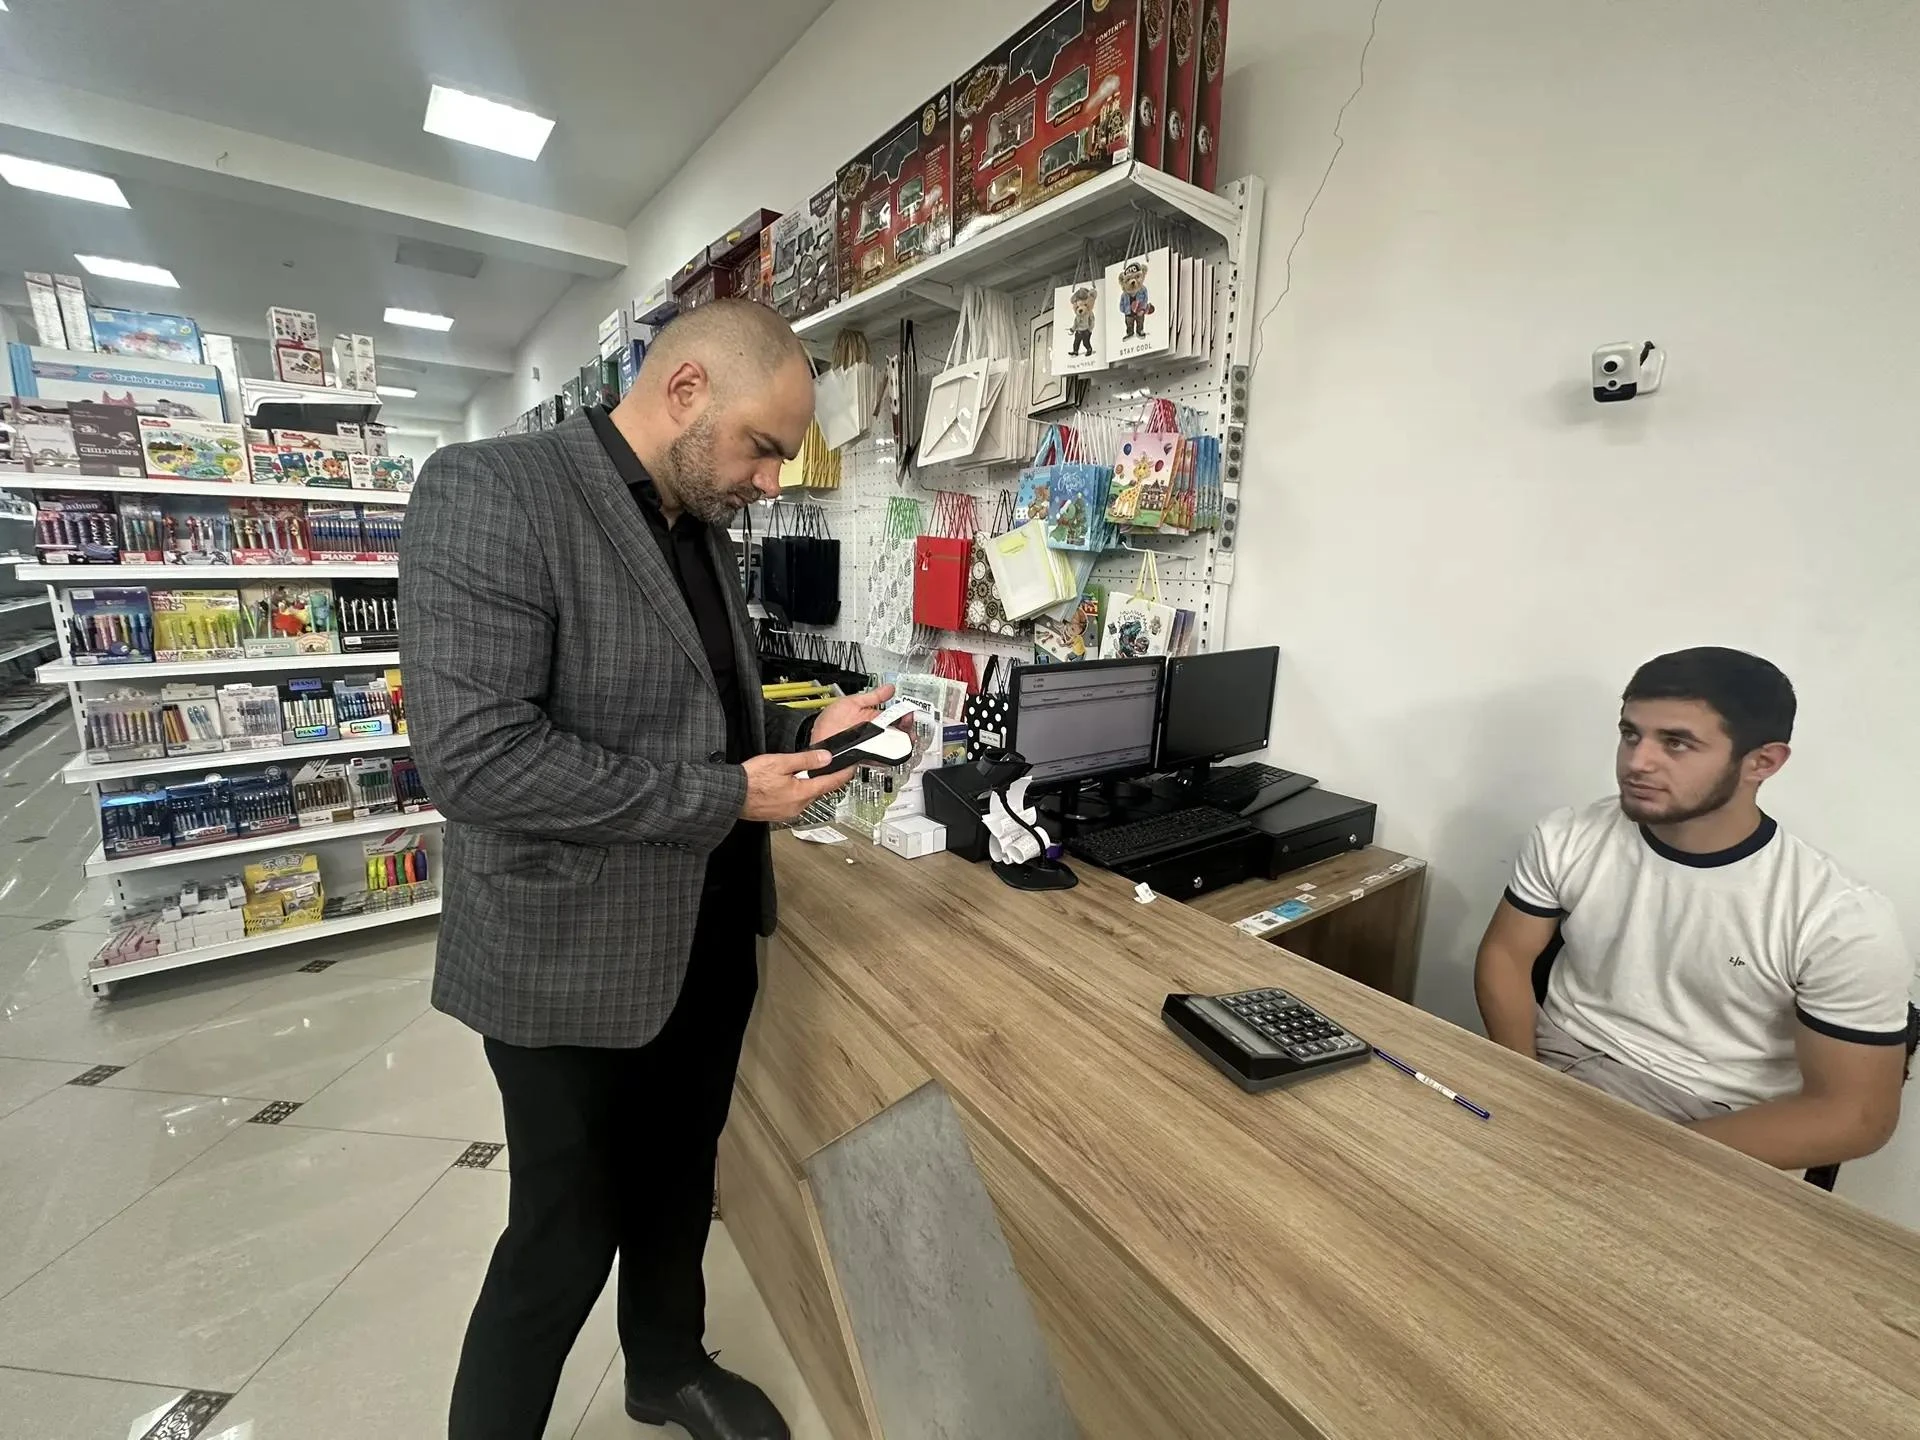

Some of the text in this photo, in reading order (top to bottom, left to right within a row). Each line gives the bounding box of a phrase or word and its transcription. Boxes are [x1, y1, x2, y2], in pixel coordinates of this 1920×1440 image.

[1120, 343, 1152, 356] STAY COOL
[113, 373, 143, 384] Train
[80, 446, 139, 456] CHILDREN'S
[65, 501, 98, 511] ashion
[321, 552, 354, 561] PIANO
[377, 554, 399, 562] PIAN
